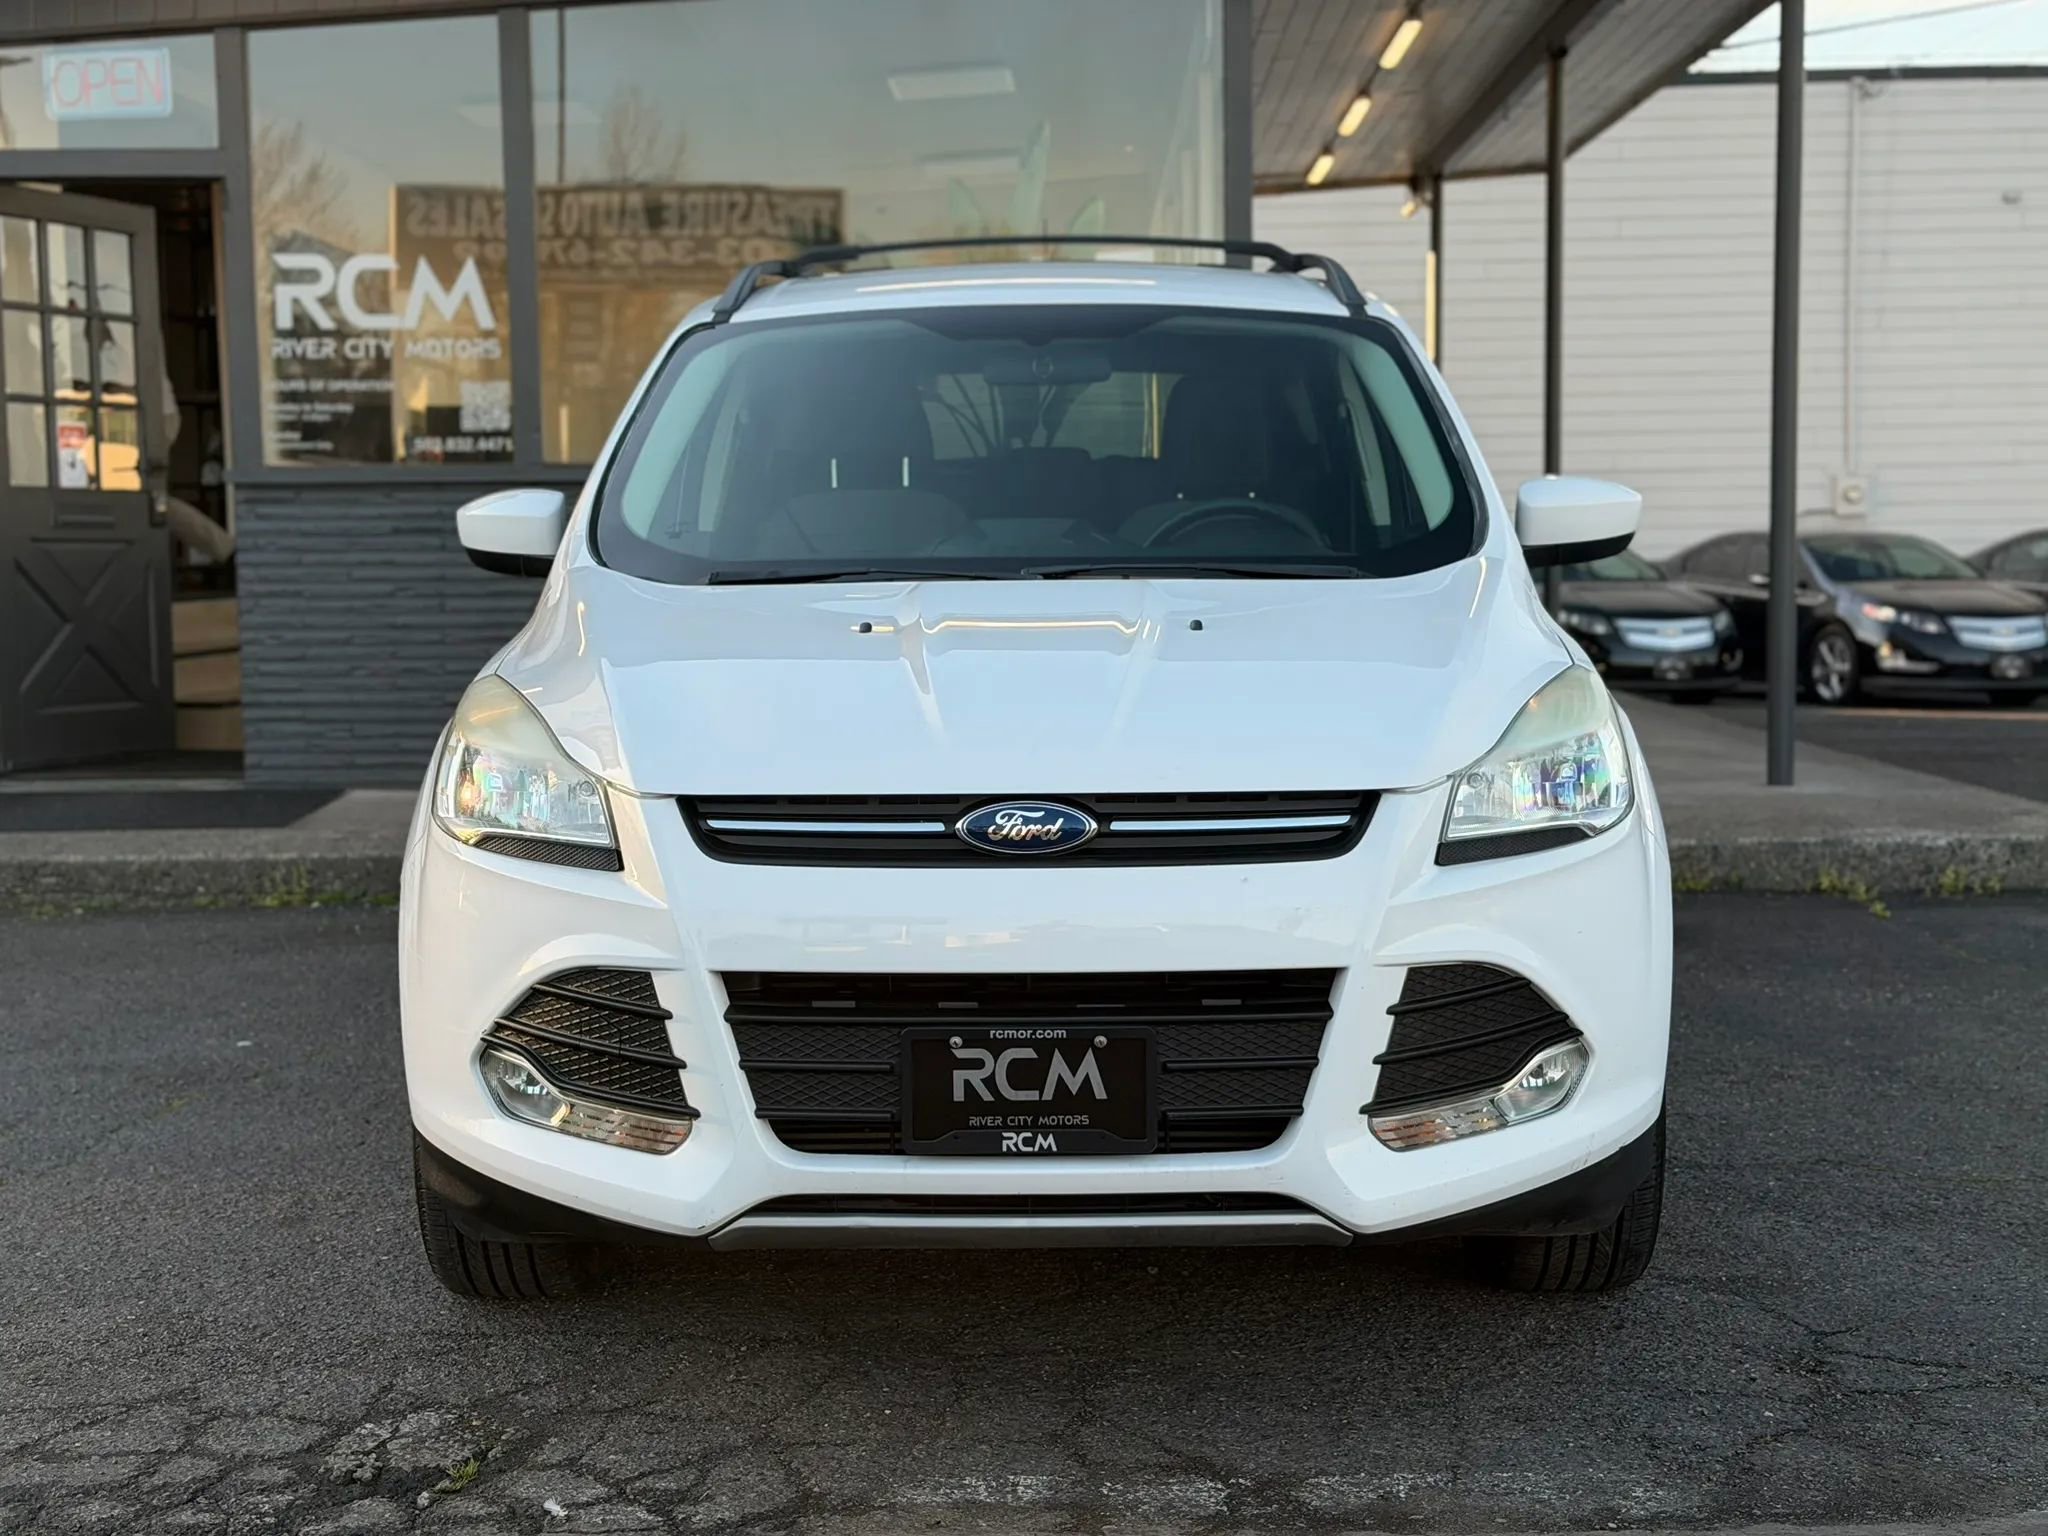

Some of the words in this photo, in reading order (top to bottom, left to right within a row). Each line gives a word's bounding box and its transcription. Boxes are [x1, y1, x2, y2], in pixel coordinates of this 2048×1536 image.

[53, 57, 162, 108] OPEN
[272, 253, 496, 330] RCM
[272, 337, 337, 359] RIVER
[344, 337, 393, 359] CITY
[405, 336, 501, 359] MOTORS
[987, 809, 1064, 841] Ford
[989, 1029, 1067, 1039] rcmor.com
[951, 1047, 1108, 1101] RCM
[969, 1115, 1003, 1127] RIVER
[1007, 1115, 1033, 1126] CITY
[1038, 1114, 1090, 1126] MOTORS
[1002, 1131, 1058, 1152] RCM
